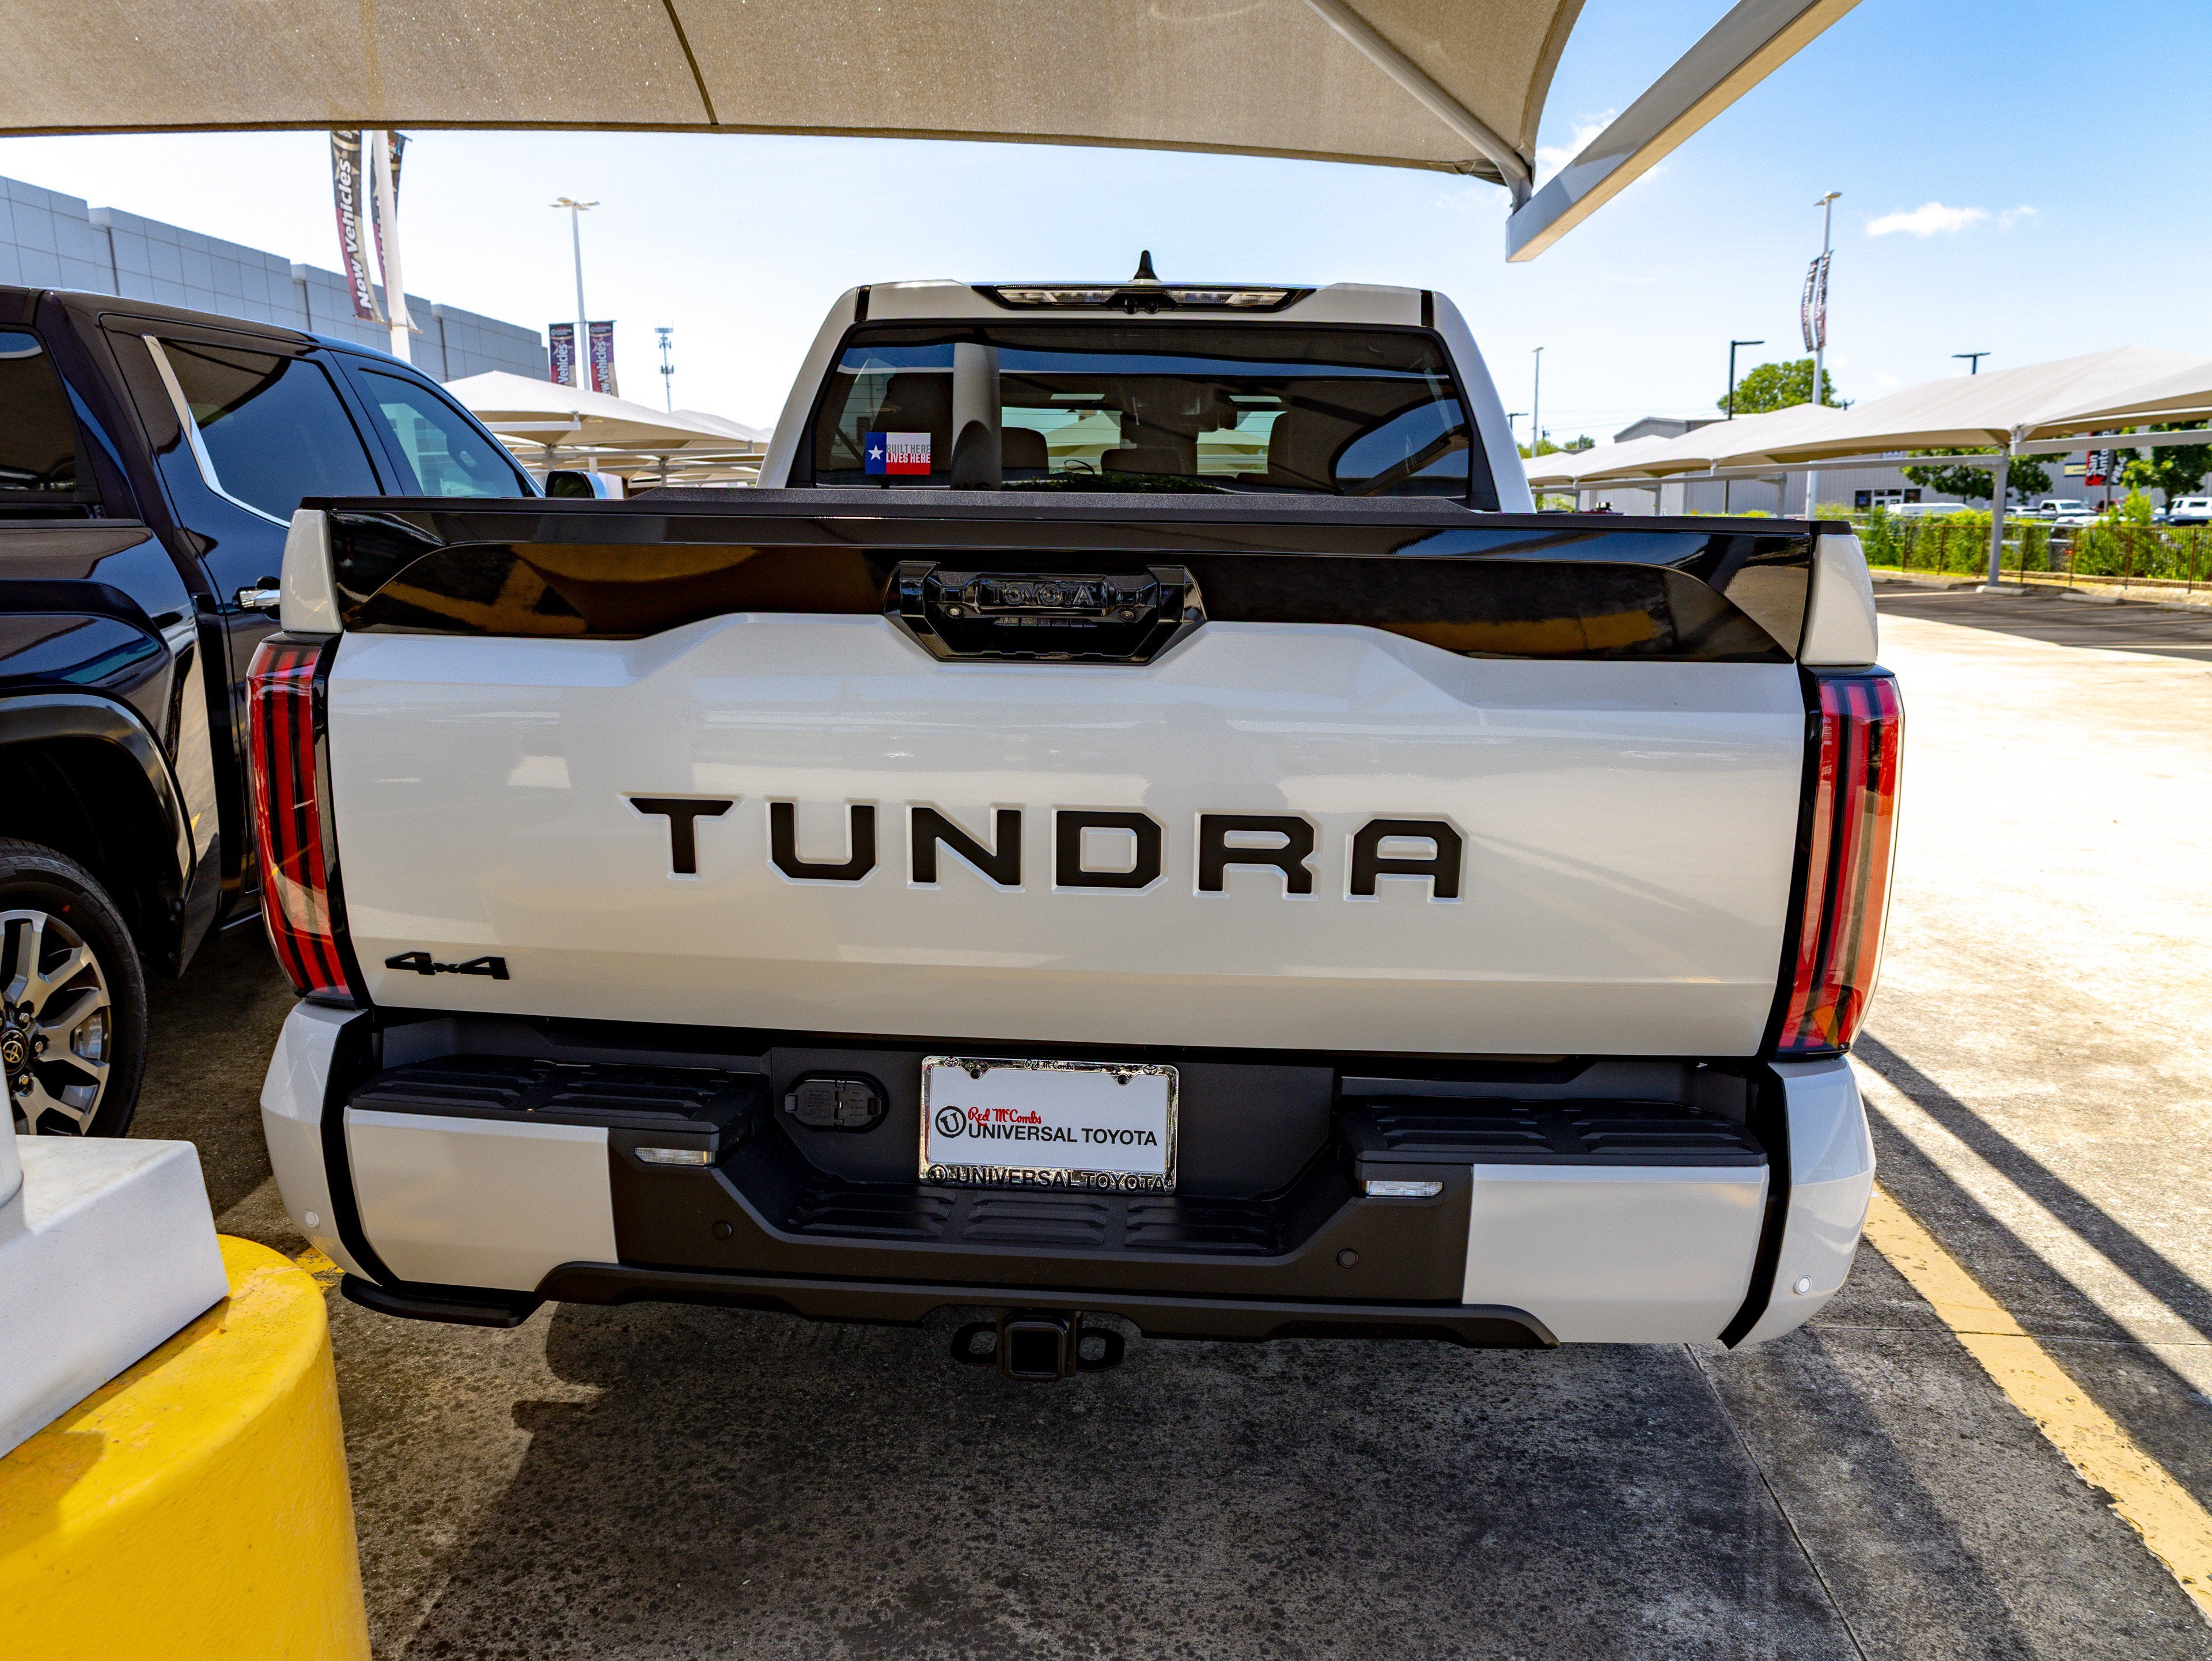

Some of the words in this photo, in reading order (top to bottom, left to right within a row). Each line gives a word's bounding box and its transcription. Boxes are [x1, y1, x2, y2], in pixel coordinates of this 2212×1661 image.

[339, 158, 358, 253] Vehicles
[351, 258, 373, 309] New
[556, 343, 570, 383] Vehicles
[596, 340, 609, 381] Vehicles
[886, 453, 908, 463] LIVES
[910, 453, 931, 464] HERE
[887, 444, 908, 453] BUILT
[911, 444, 931, 454] HERE
[2085, 455, 2099, 476] San
[986, 582, 1095, 606] TOYOTA
[627, 796, 1465, 902] TUNDRA
[968, 1107, 991, 1127] Red
[991, 1107, 1042, 1125] McCombs
[968, 1123, 1078, 1143] UNIVERSAL
[1081, 1127, 1158, 1147] TOYOTA
[956, 1164, 1080, 1189] UNIVERSAL
[1081, 1171, 1167, 1193] TOYOTA
